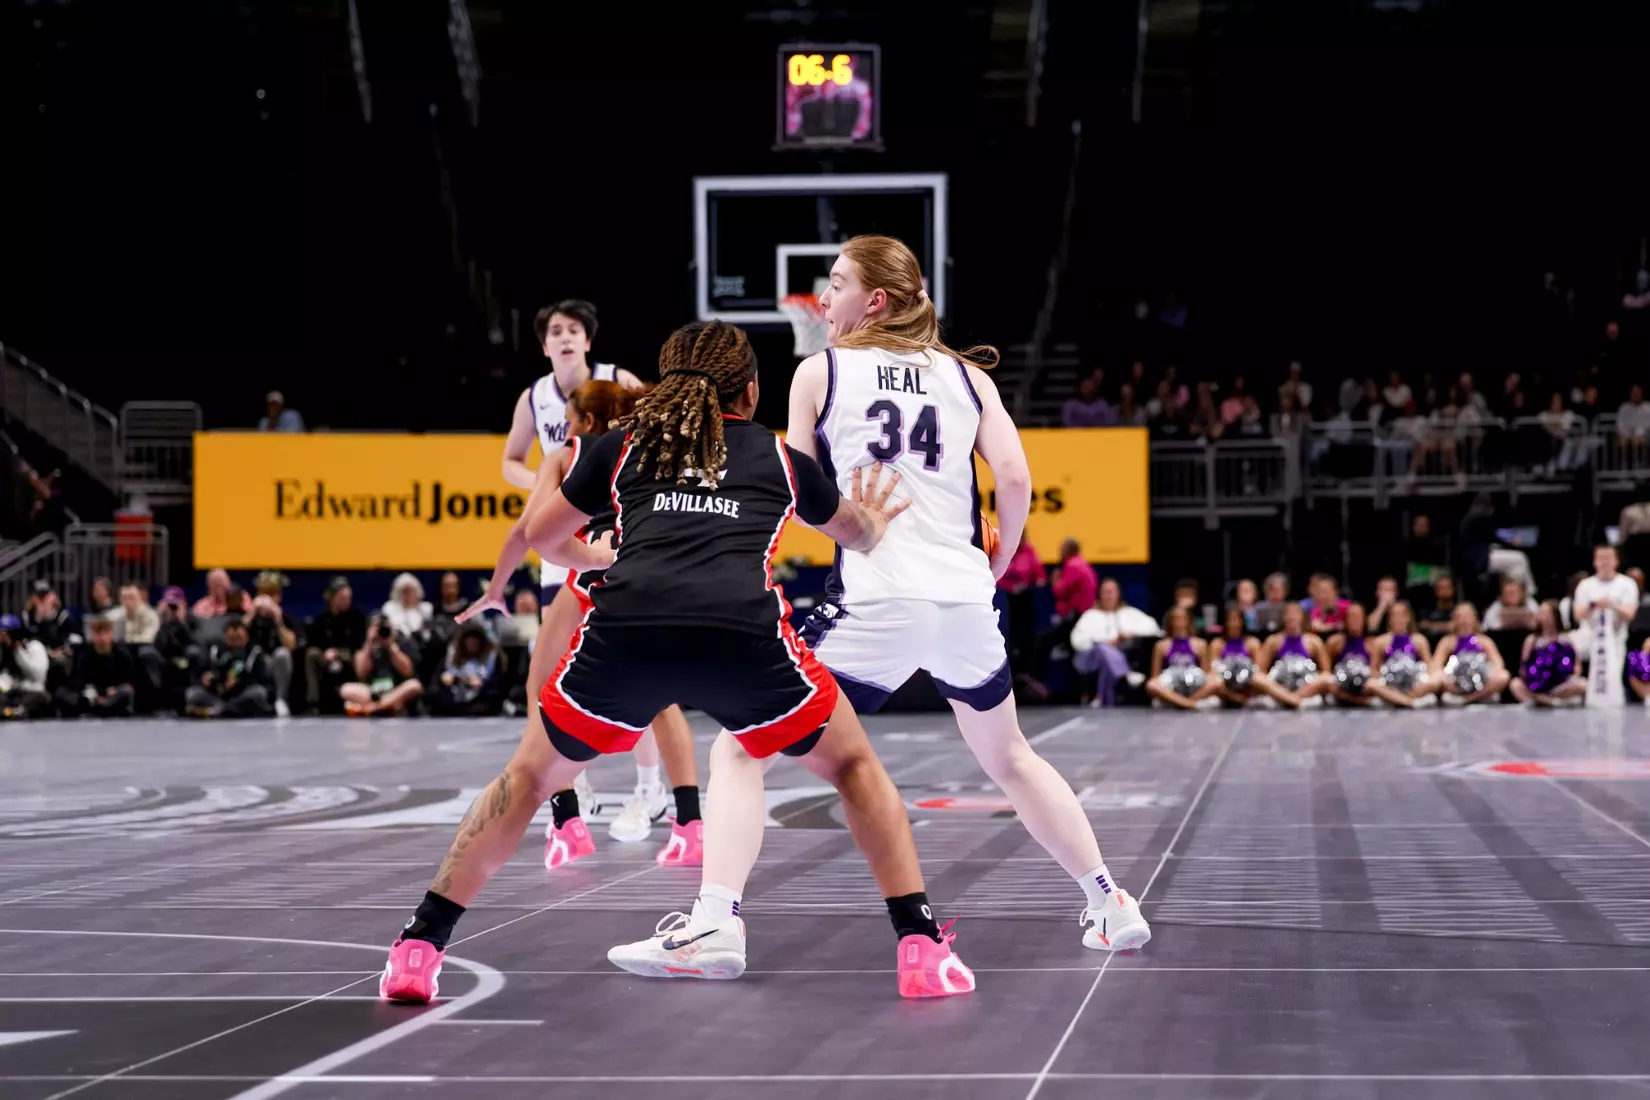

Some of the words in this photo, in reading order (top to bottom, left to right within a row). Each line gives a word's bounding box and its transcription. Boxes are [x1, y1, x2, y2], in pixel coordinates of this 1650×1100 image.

[877, 365, 927, 395] HEAL
[865, 399, 944, 472] 34
[274, 478, 422, 520] Edward
[426, 480, 526, 526] Jone
